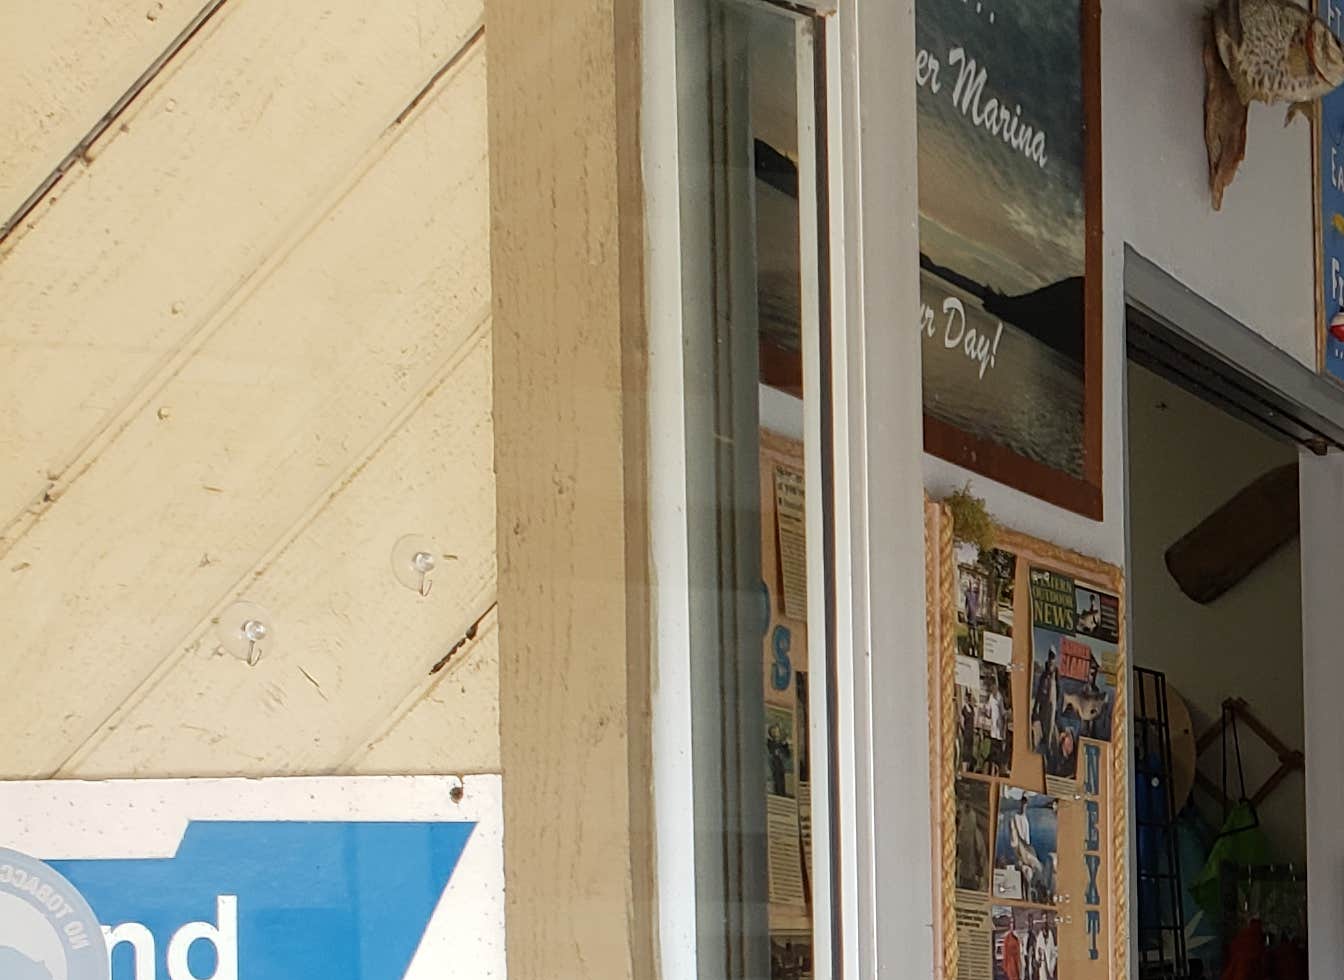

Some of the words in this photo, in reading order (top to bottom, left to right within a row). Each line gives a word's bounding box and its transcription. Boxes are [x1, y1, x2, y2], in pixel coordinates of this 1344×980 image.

[949, 47, 1047, 168] Marina
[943, 297, 1003, 380] Day!
[1034, 600, 1073, 631] NEWS
